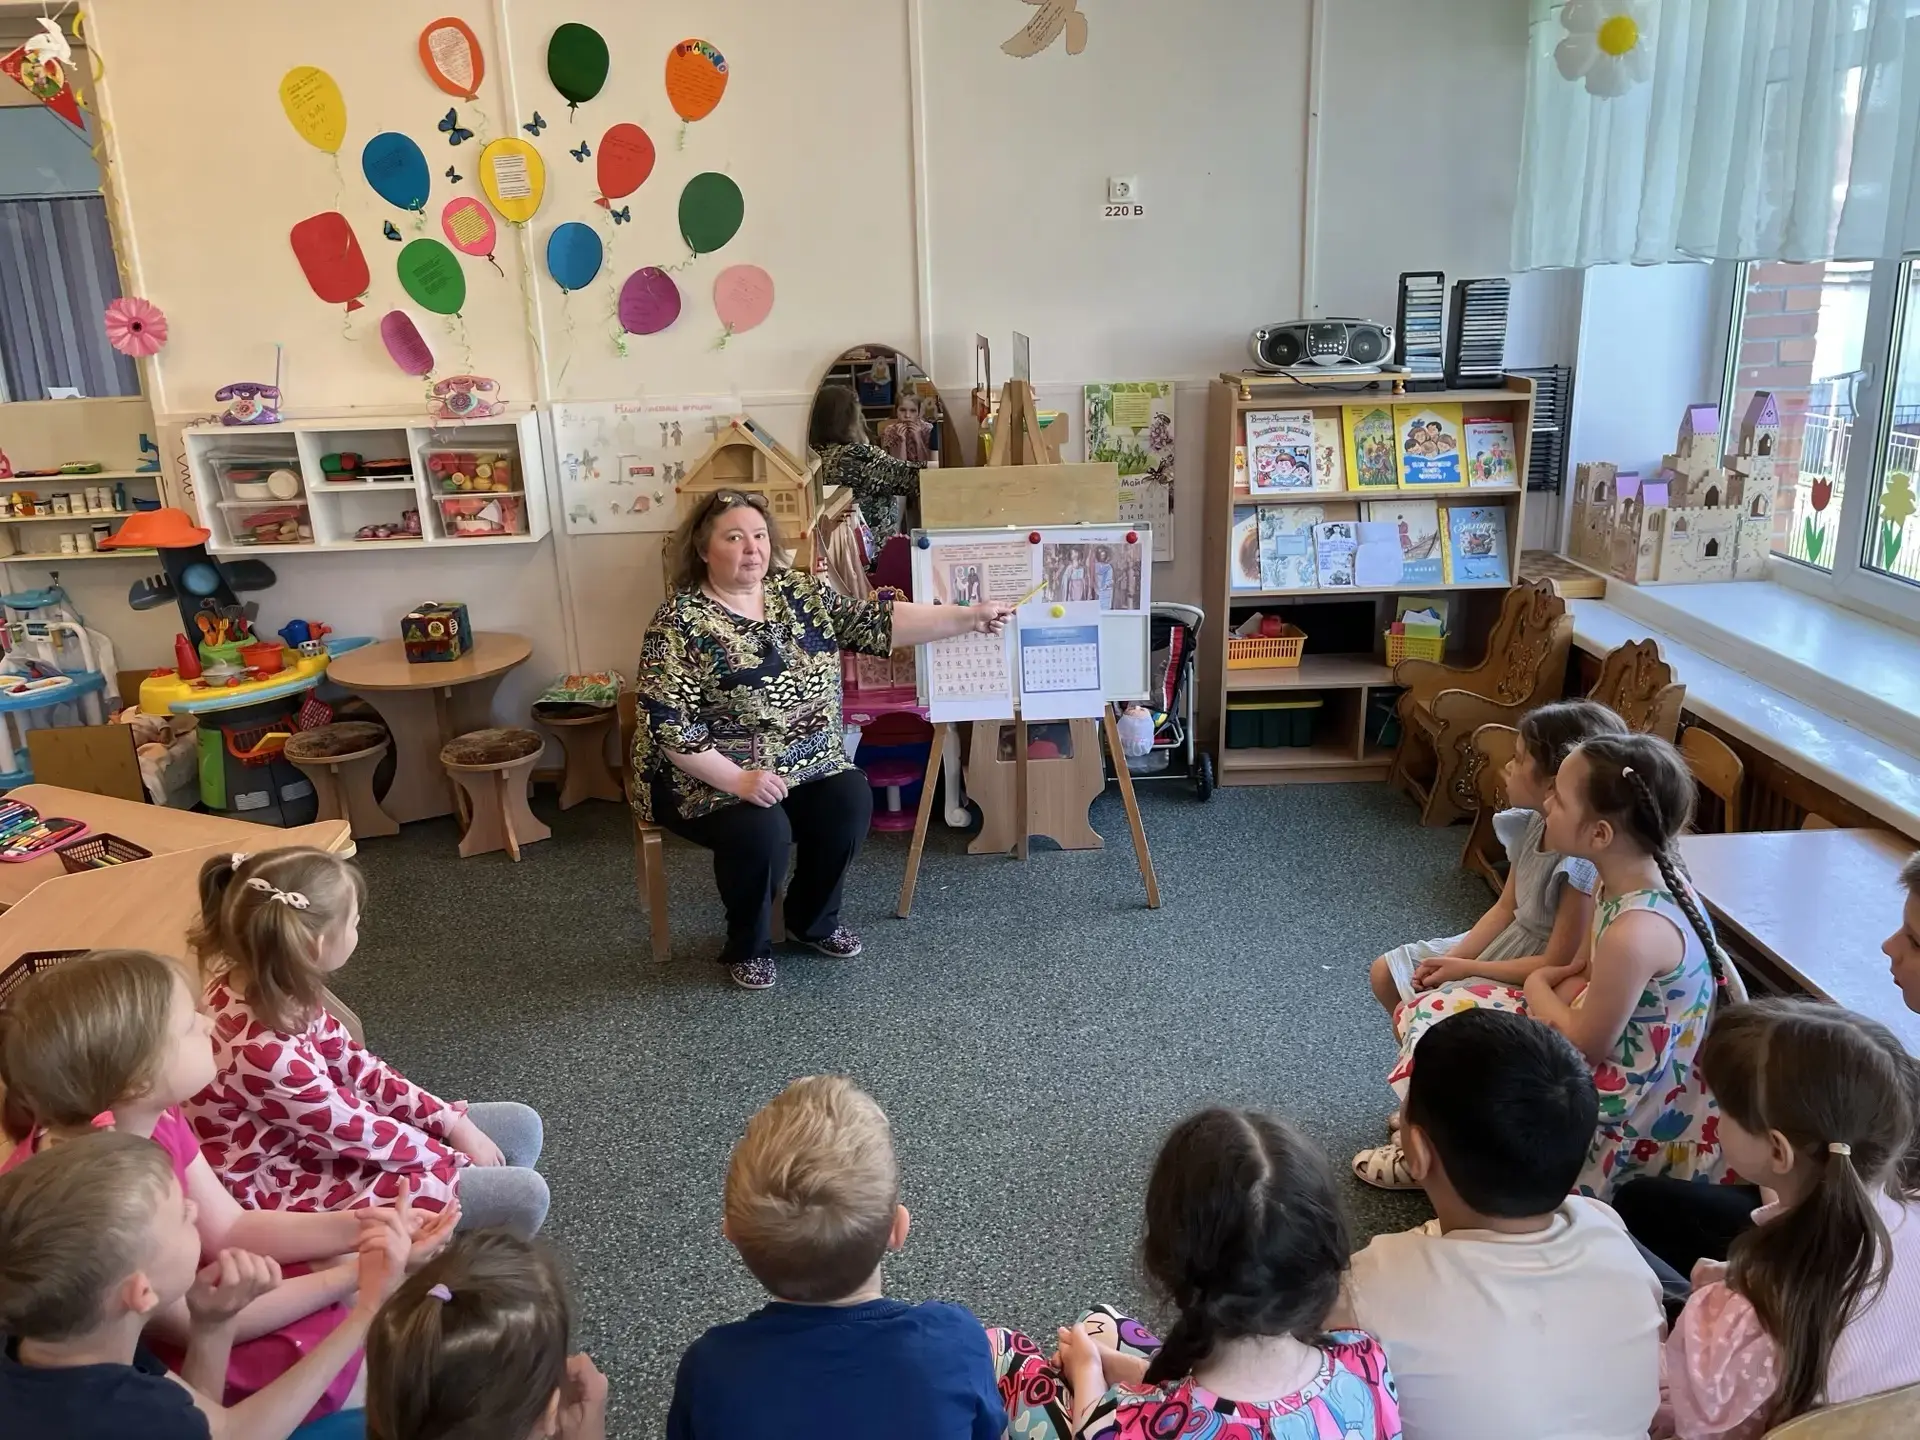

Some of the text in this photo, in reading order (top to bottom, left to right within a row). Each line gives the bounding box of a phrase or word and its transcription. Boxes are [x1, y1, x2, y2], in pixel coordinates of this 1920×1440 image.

[1105, 206, 1129, 216] 220
[1121, 478, 1141, 488] Май
[1129, 503, 1134, 511] 7
